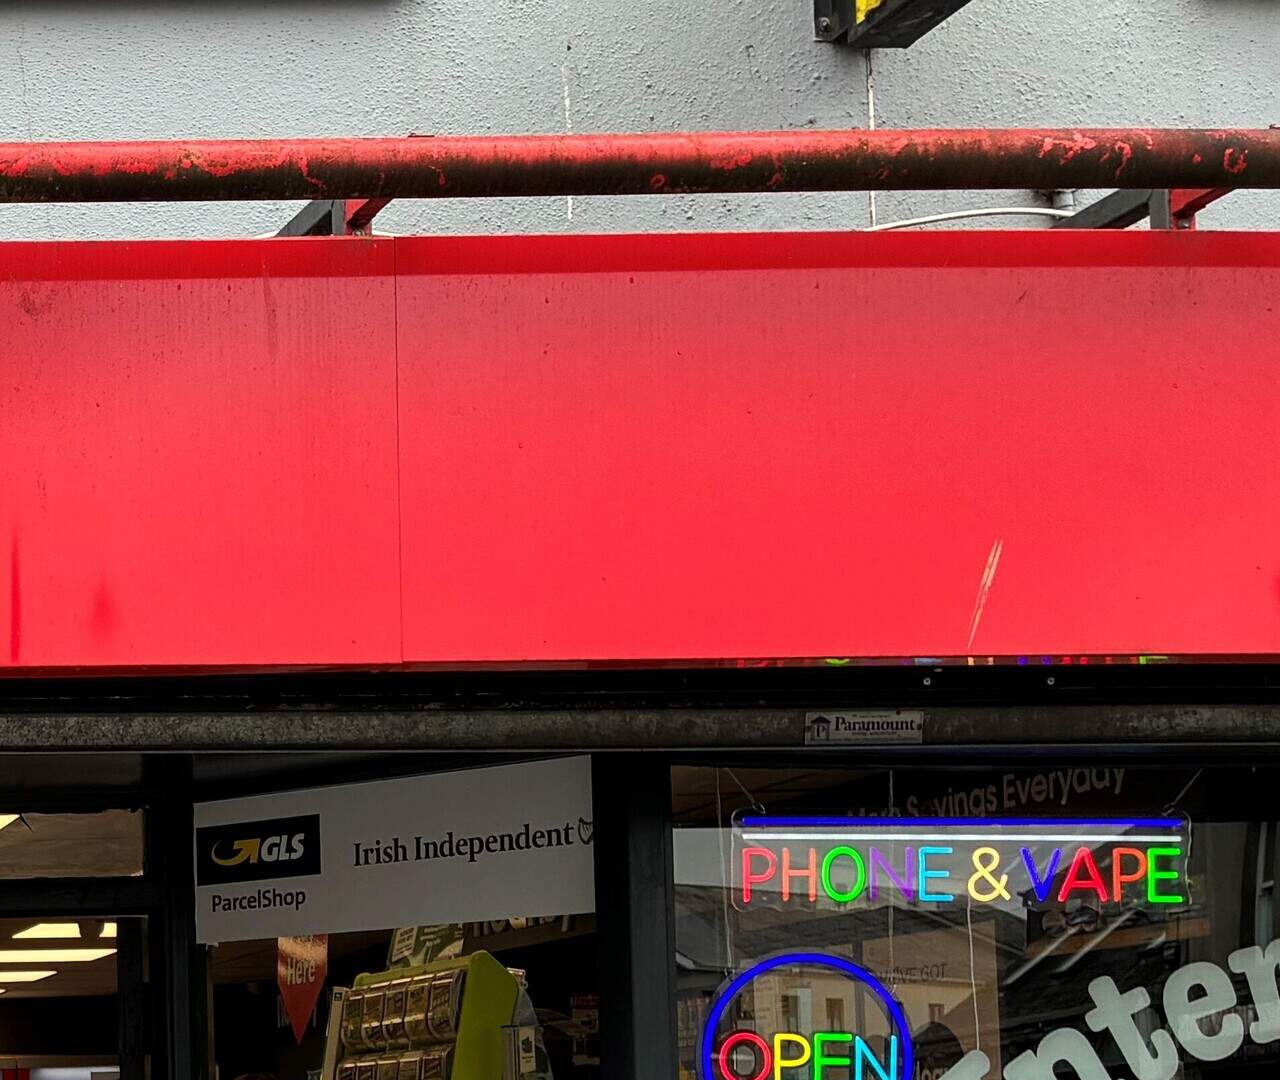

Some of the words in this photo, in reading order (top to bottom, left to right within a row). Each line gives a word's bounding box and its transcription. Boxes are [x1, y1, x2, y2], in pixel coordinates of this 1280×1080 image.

[835, 716, 916, 731] Paramount
[261, 832, 305, 863] GLS
[353, 838, 408, 867] Irish
[414, 822, 574, 863] Independent
[741, 846, 955, 903] PHONE
[967, 846, 1011, 903] &
[1021, 846, 1183, 903] VAPE
[212, 888, 306, 912] ParcelShop
[287, 957, 316, 985] Here
